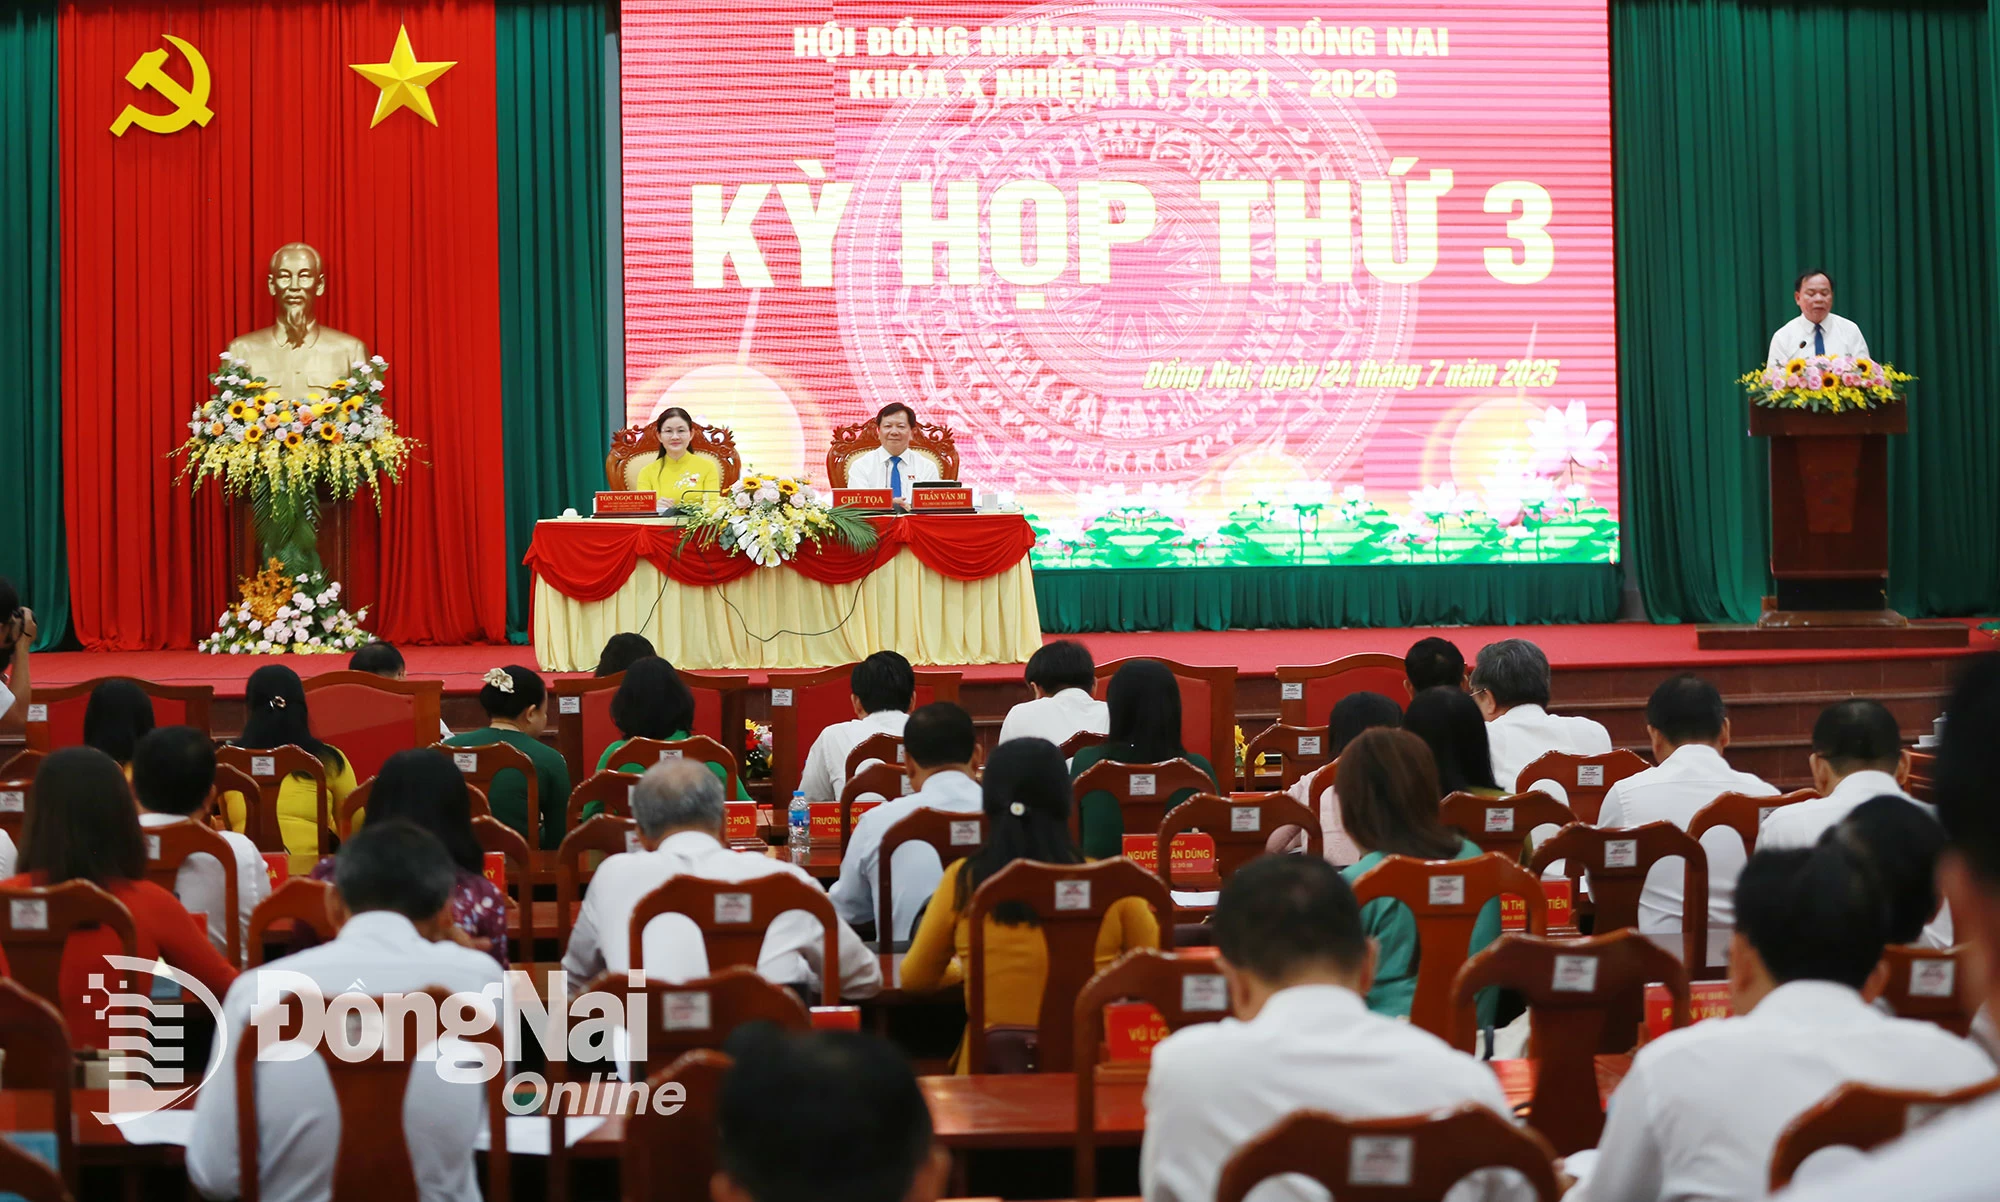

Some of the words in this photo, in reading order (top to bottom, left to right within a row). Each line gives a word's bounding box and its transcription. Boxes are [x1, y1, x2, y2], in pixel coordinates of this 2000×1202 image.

[794, 22, 855, 62] HỘI
[866, 17, 968, 57] ĐỒNG
[980, 20, 1084, 57] NHÂN
[1097, 19, 1172, 57] DÂN
[1186, 17, 1266, 57] TỈNH
[1275, 17, 1376, 57] ĐỒNG
[1387, 26, 1449, 57] NAI
[849, 65, 949, 99] KHÓA
[962, 68, 986, 99] X
[996, 63, 1117, 104] NHIỆM
[1186, 68, 1270, 99] 2021
[1310, 68, 1398, 99] 2026
[691, 159, 855, 288] KỲ
[900, 179, 1157, 310] HỌP
[1199, 156, 1454, 285] THỨ
[1483, 180, 1555, 285] 3
[1143, 357, 1203, 390] Đồng
[1207, 360, 1252, 391] Nai,
[1259, 362, 1317, 391] ngày
[1321, 360, 1351, 388] 24
[1357, 360, 1421, 389] tháng
[1426, 360, 1444, 388] 7
[1447, 358, 1497, 388] năm
[1499, 358, 1561, 388] 2025
[840, 493, 862, 505] CHỦ
[864, 495, 884, 505] TỌA
[919, 490, 939, 501] TRẦN
[940, 491, 956, 501] VĂN
[1127, 848, 1158, 860] NGUYỄ
[1184, 847, 1210, 859] DŨNG
